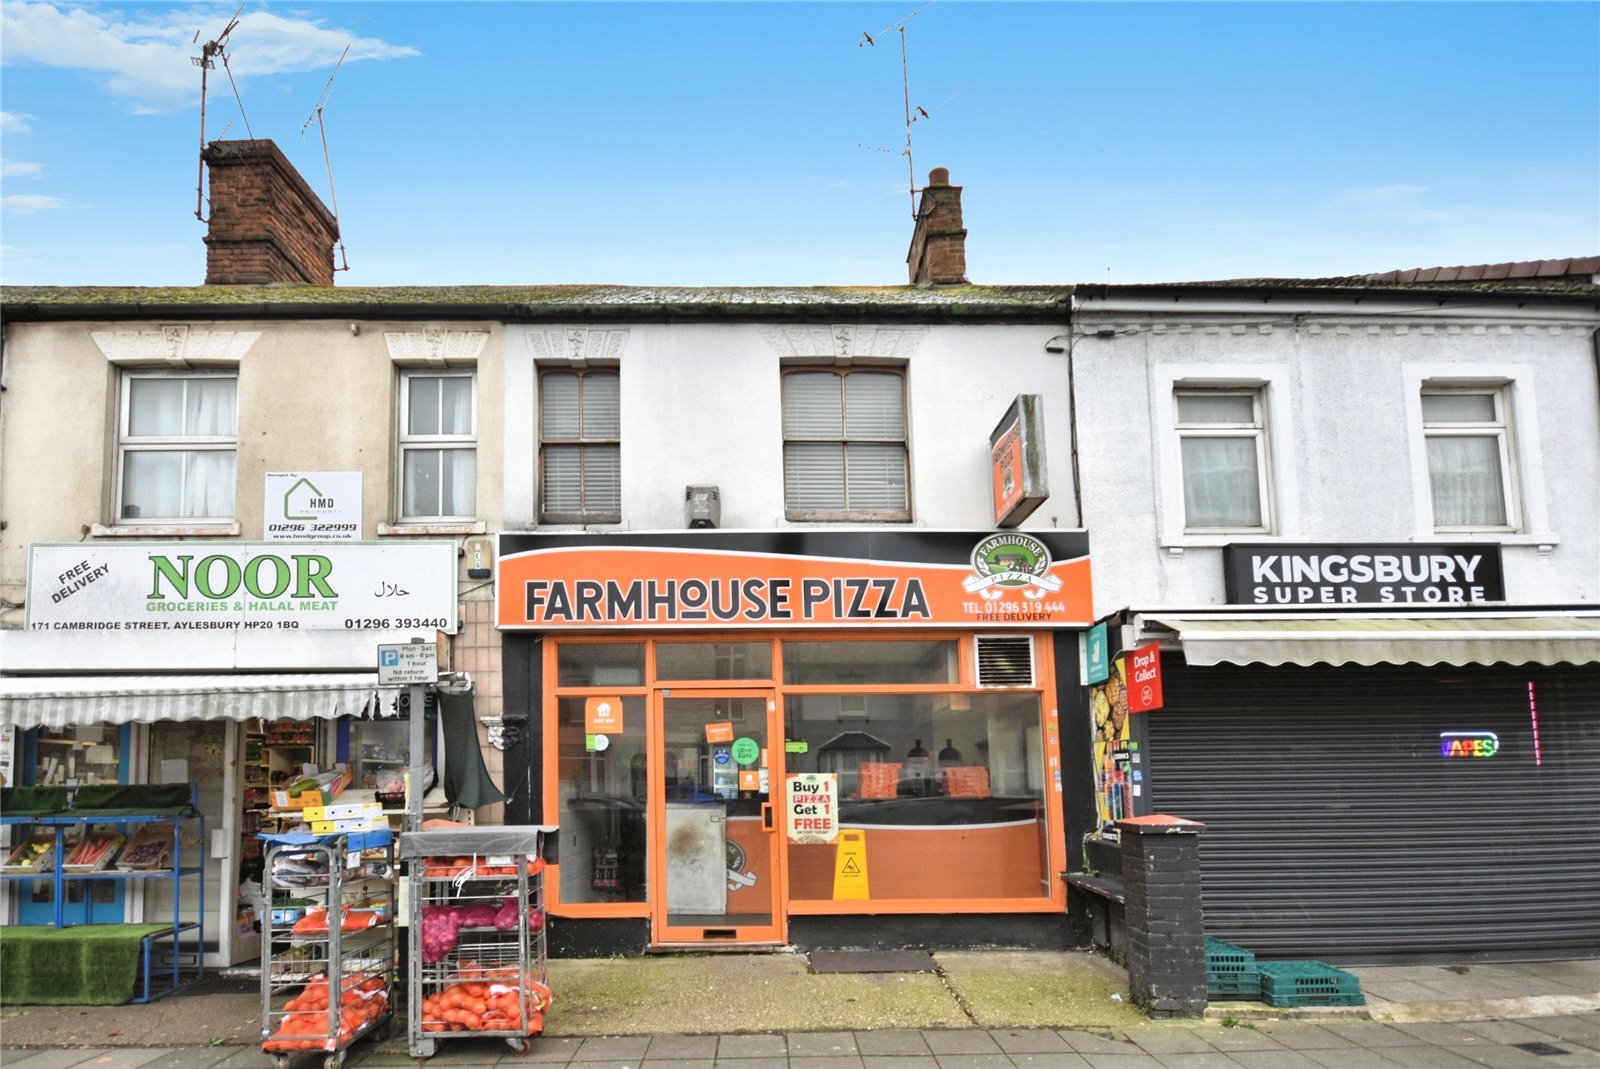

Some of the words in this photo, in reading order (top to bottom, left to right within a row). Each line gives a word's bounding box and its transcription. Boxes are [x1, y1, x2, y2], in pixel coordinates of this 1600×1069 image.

[310, 498, 334, 508] HMD
[268, 524, 305, 532] 01296
[310, 524, 357, 532] 322999
[980, 536, 1043, 557] FARMHOUSE
[58, 560, 91, 584] FREE
[1252, 555, 1482, 583] KINGSBURY
[51, 562, 110, 604] DELIVERY
[147, 554, 339, 600] NOOR
[991, 573, 1032, 582] PIZZA
[374, 580, 410, 598] حلال
[1253, 586, 1358, 604] SUPER
[1380, 586, 1486, 604] STORE
[146, 602, 228, 612] GROCERIES
[233, 601, 243, 611] &
[248, 601, 295, 611] HALAL
[300, 600, 338, 611] MEAT
[525, 578, 793, 622] FARMHOUSE
[802, 577, 932, 620] PIZZA
[985, 602, 1020, 613] 01296
[1022, 602, 1042, 612] 319
[1044, 601, 1066, 612] 444
[976, 612, 1001, 621] FREE
[1003, 612, 1052, 621] DELIVERY
[31, 622, 50, 630] 171
[53, 622, 121, 630] CAMBRIDGE
[174, 622, 240, 630] AYLESBURY
[244, 621, 273, 630] HP20
[276, 621, 300, 630] 1BQ
[344, 618, 390, 629] 01296
[394, 618, 448, 629] 393440
[385, 652, 396, 665] P
[1134, 655, 1150, 668] Drop
[1150, 650, 1156, 663] &
[1135, 668, 1156, 683] Collect
[1441, 740, 1494, 757] VAPES
[793, 782, 820, 794] Buy
[824, 781, 829, 792] 1
[794, 804, 818, 815] Get
[824, 804, 830, 814] 1
[794, 818, 831, 830] FREE
